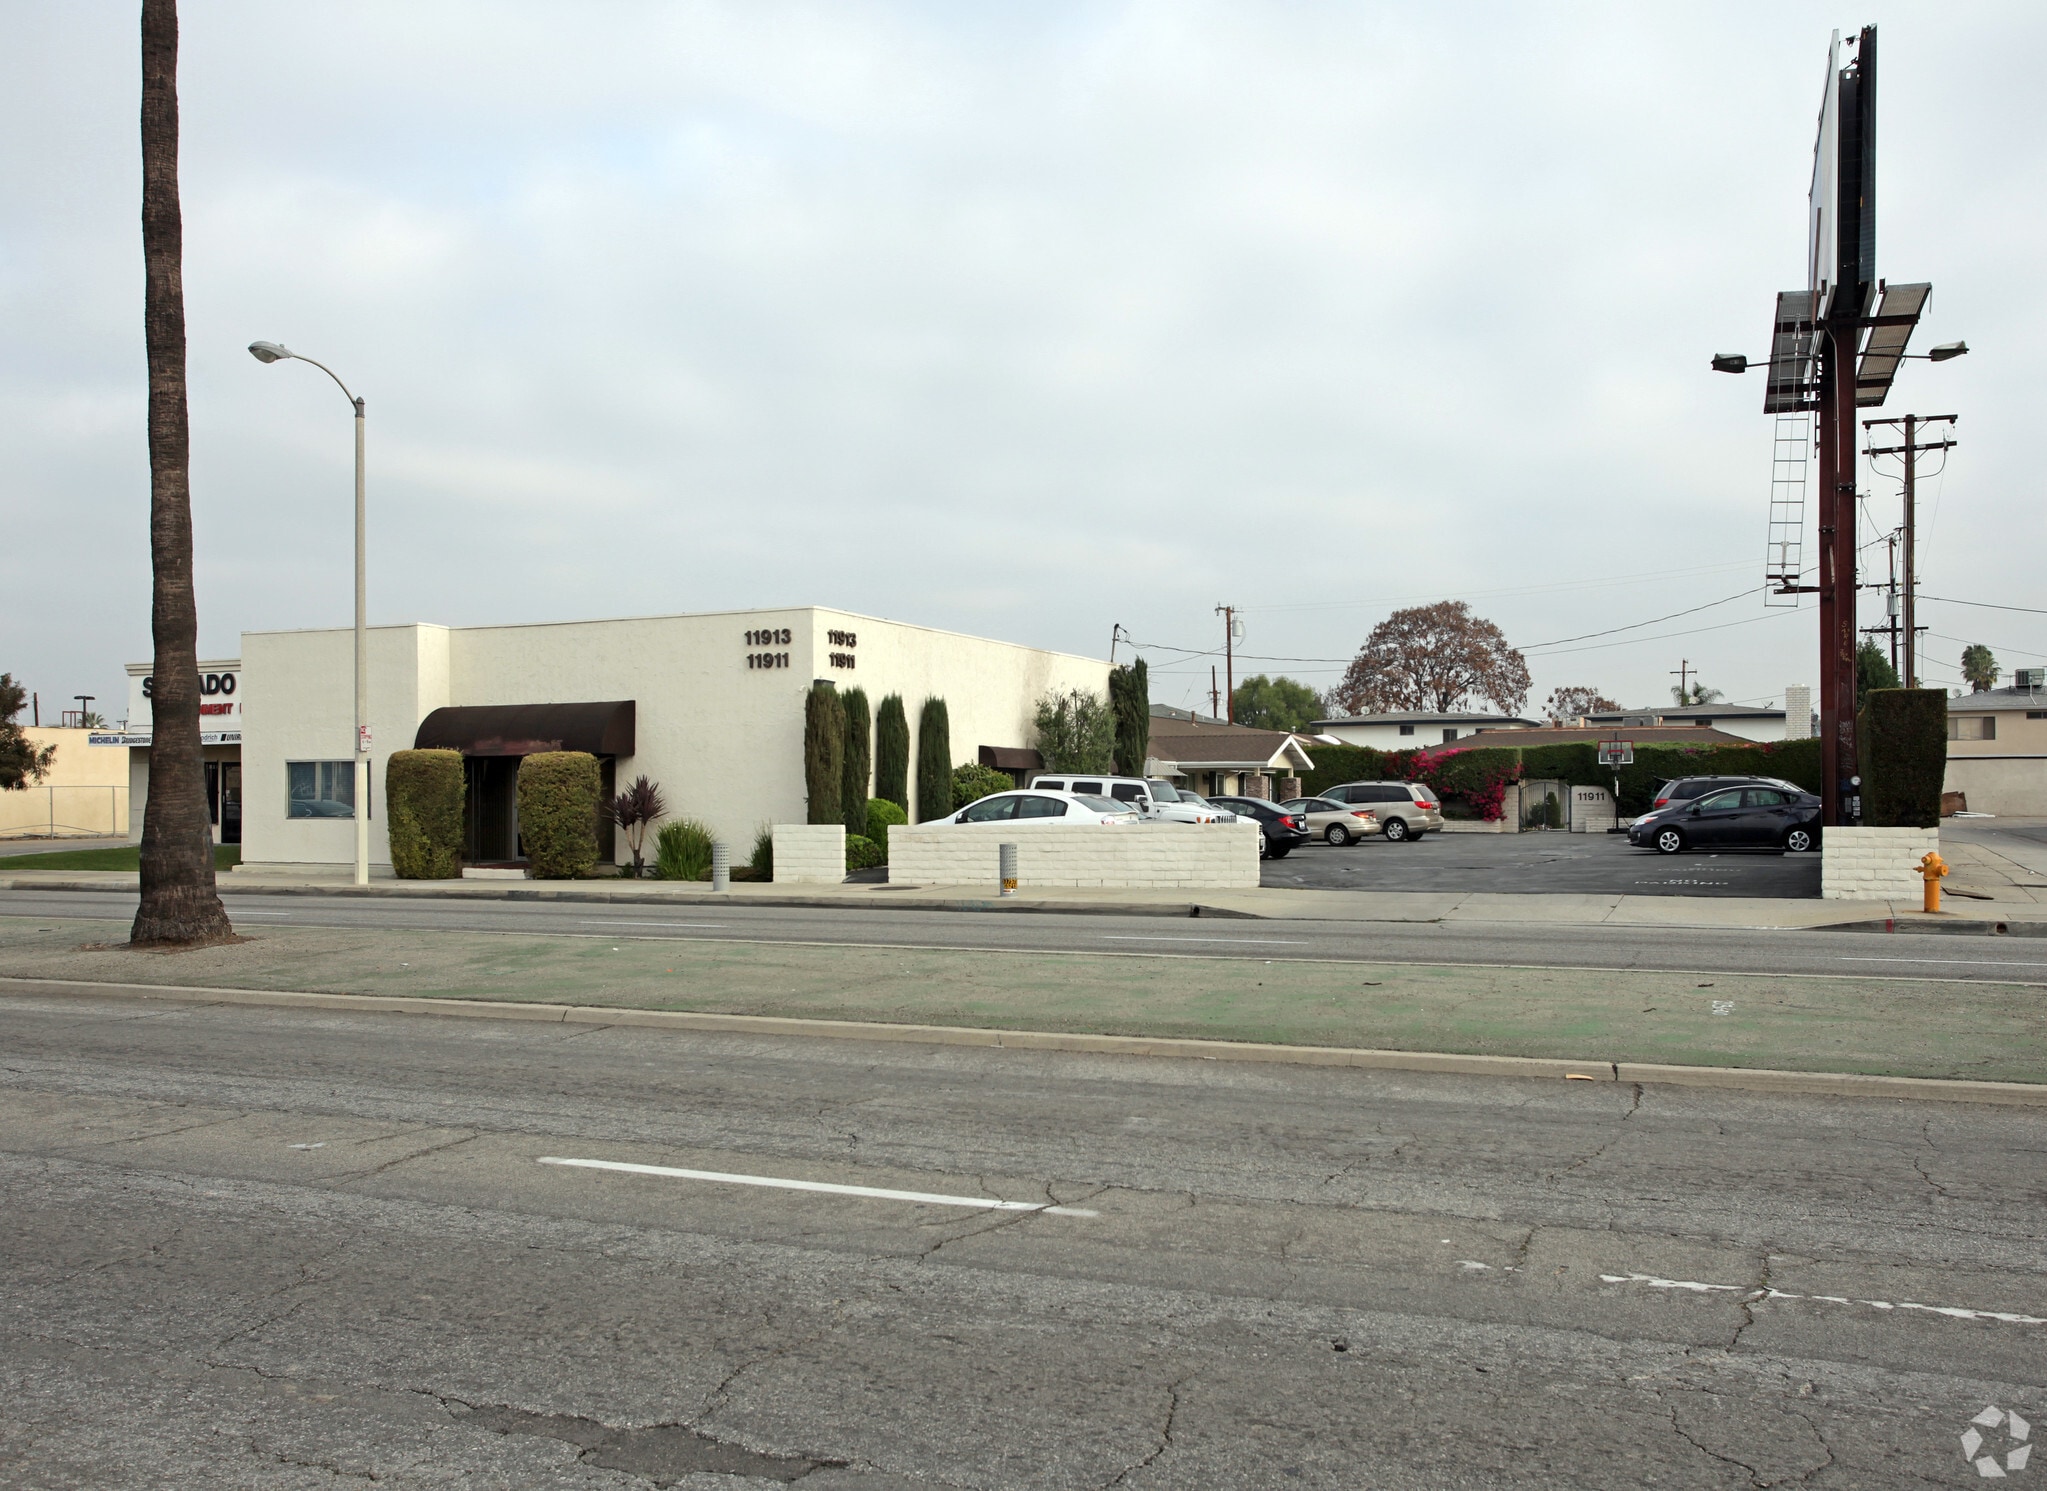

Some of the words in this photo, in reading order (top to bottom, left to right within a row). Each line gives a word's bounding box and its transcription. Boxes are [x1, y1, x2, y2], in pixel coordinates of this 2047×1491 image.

[744, 628, 792, 646] 11913
[827, 629, 857, 648] 11913
[746, 652, 790, 669] 11911
[829, 652, 855, 670] 11911
[88, 736, 120, 744] MICHELIN
[1577, 792, 1605, 801] 11911
